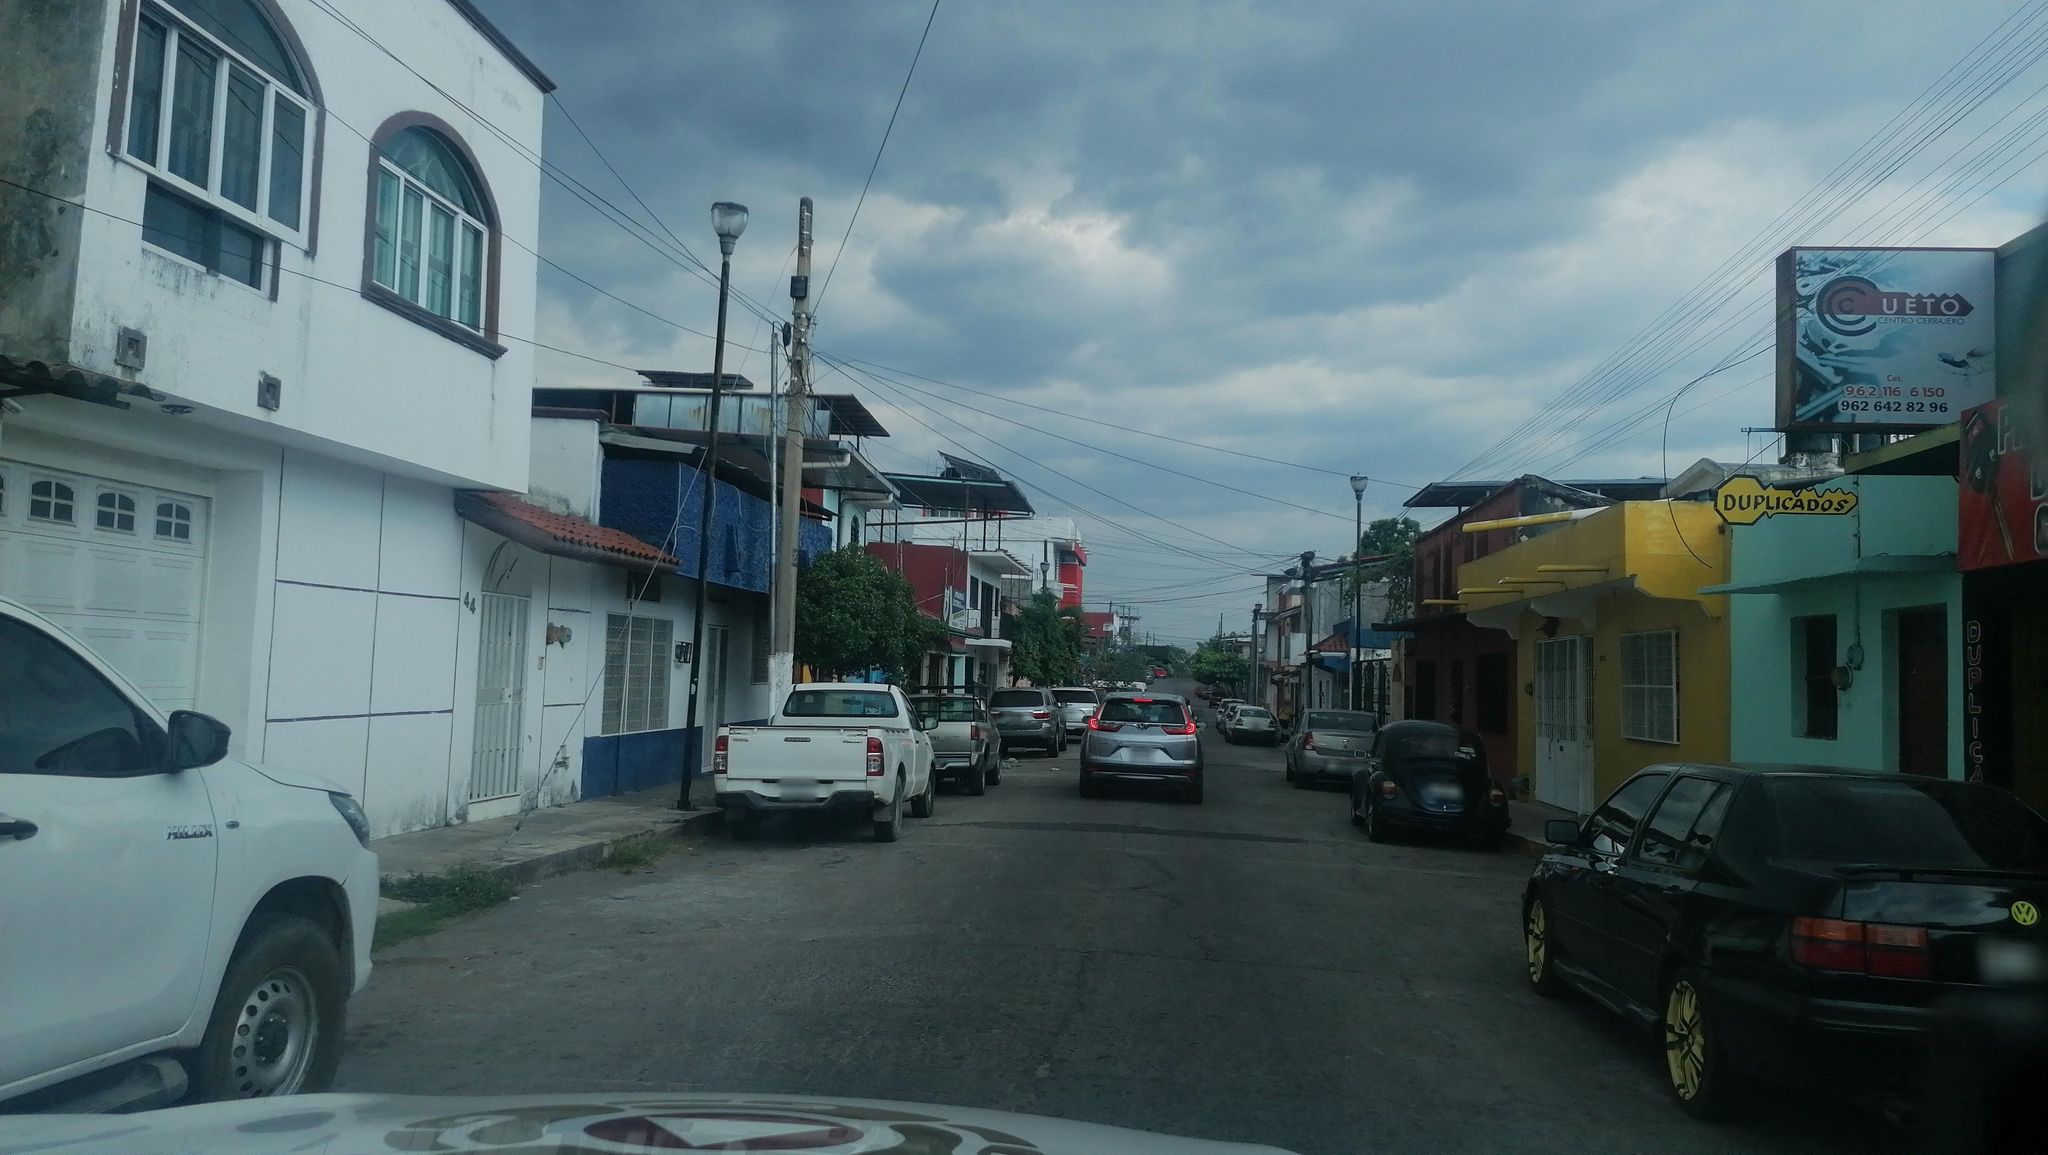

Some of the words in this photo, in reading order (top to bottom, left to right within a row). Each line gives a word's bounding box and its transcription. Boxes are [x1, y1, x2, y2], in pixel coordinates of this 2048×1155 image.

[1878, 317, 1914, 326] CENTRO
[1916, 318, 1966, 326] CERRAJERO
[1845, 386, 1877, 396] 962
[1882, 386, 1902, 397] 116
[1841, 400, 1869, 411] 962
[1873, 401, 1902, 412] 642
[1906, 401, 1925, 412] 82
[1929, 402, 1948, 413] 96
[1723, 494, 1852, 513] DUPLICADOS
[464, 591, 476, 614] 44
[166, 823, 213, 840] HILUX
